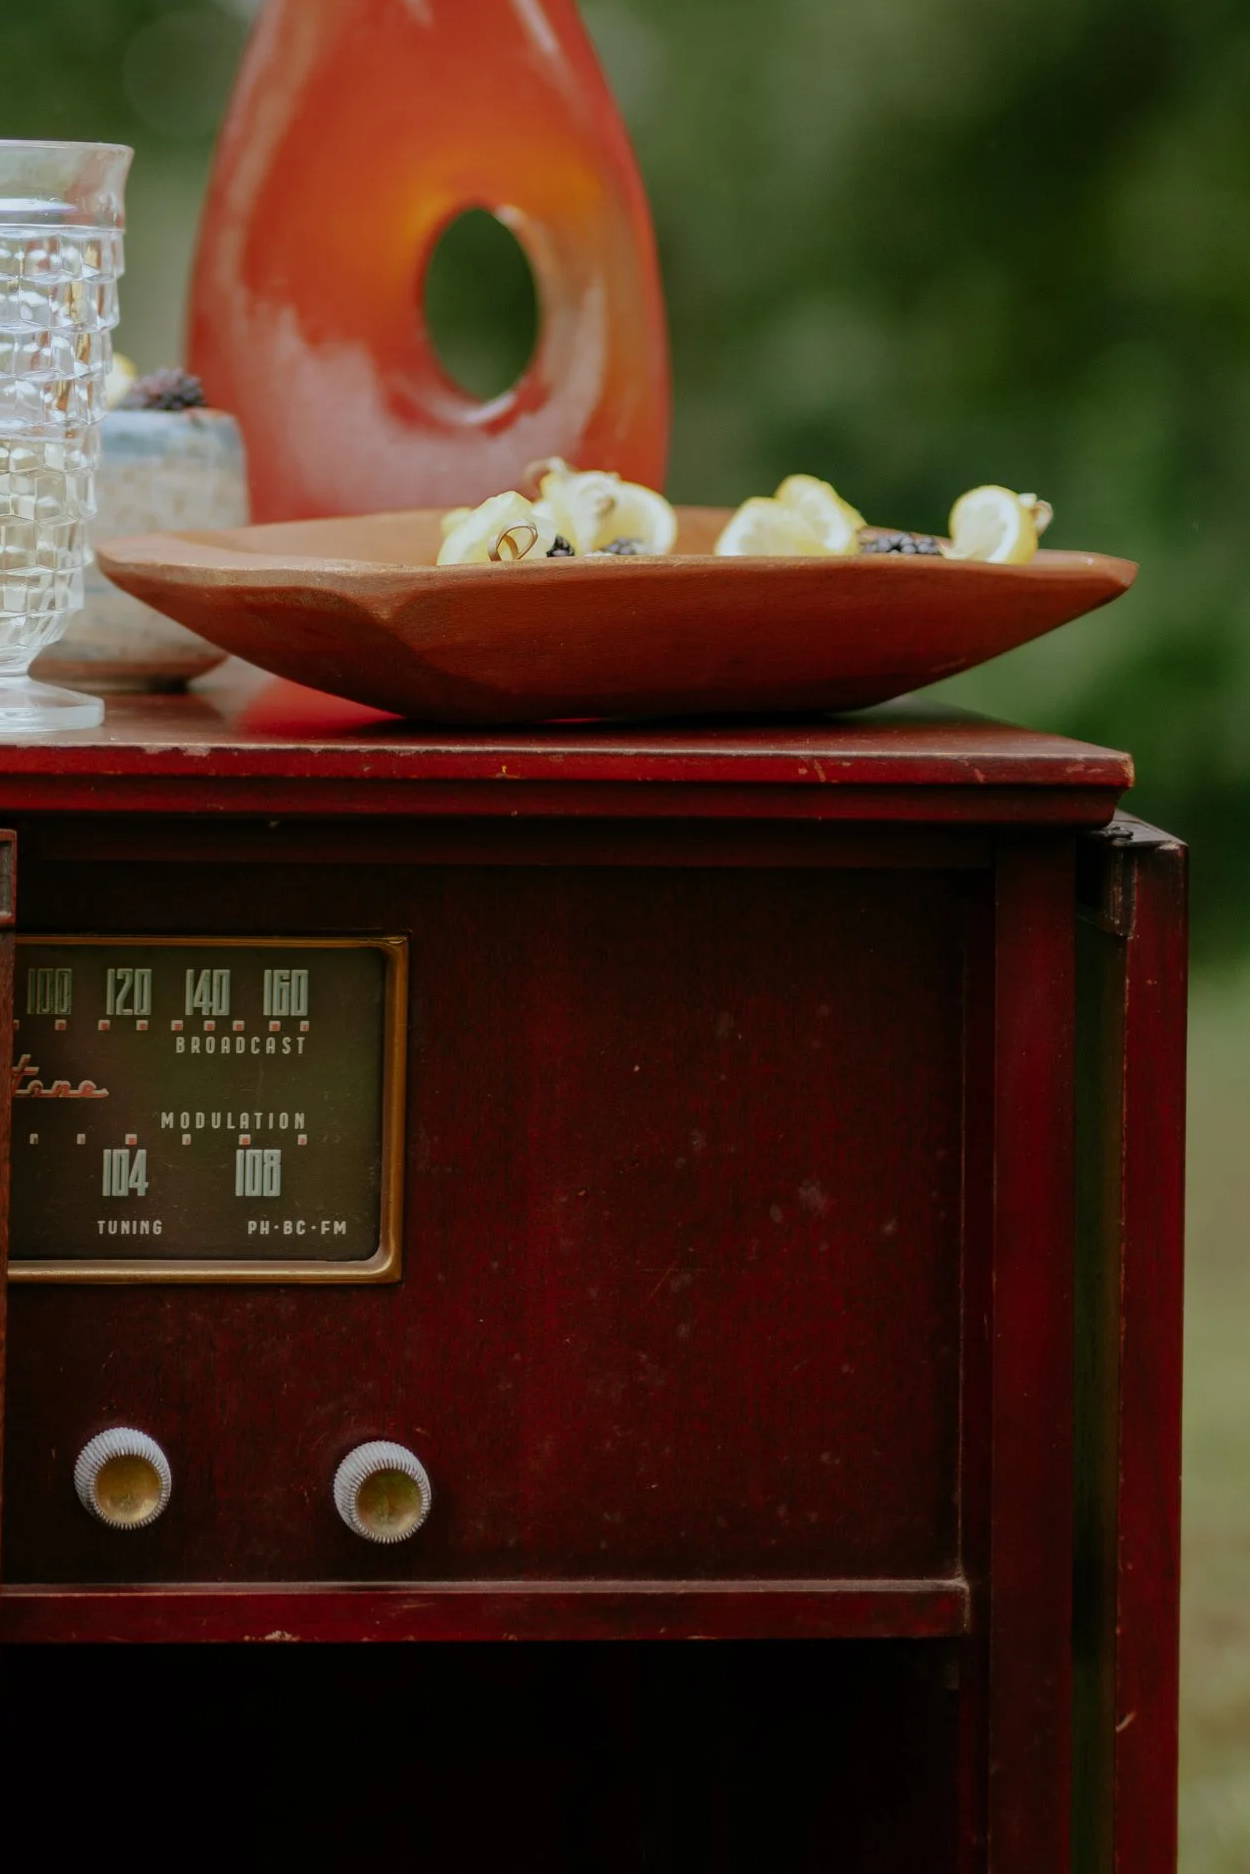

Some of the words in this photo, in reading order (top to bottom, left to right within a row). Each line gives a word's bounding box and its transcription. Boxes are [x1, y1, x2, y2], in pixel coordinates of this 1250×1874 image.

[27, 968, 73, 1015] 100
[106, 968, 152, 1016] 120
[185, 969, 230, 1016] 140
[263, 969, 309, 1016] 160
[175, 1036, 306, 1055] BROADCAST
[161, 1112, 305, 1130] MODULATION
[103, 1148, 149, 1197] 104
[235, 1148, 281, 1197] 108
[97, 1220, 163, 1235] TUNING
